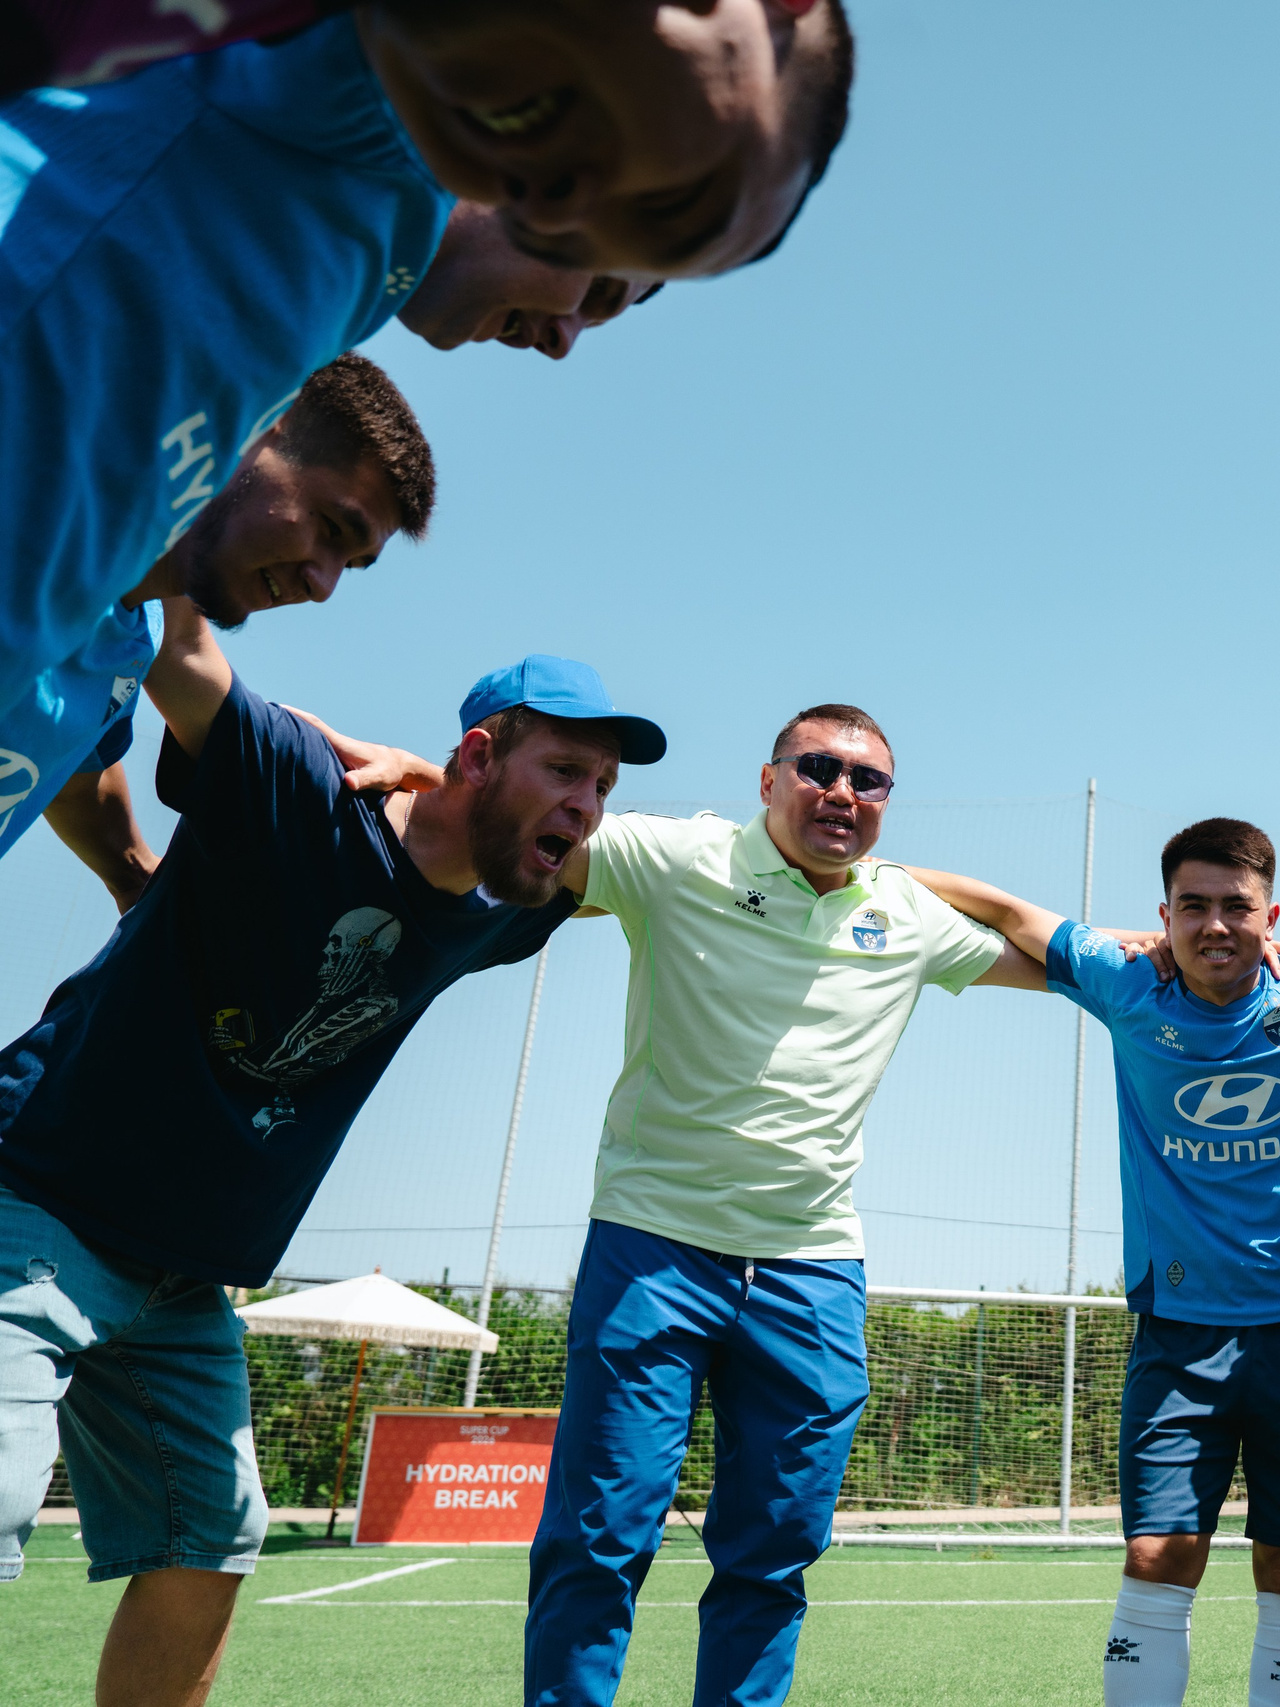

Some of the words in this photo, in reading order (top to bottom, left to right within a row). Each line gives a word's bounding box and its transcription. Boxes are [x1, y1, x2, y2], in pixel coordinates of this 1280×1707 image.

[734, 900, 767, 918] KELME
[1155, 1036, 1185, 1051] KELME
[460, 1425, 489, 1435] SUPER
[490, 1425, 510, 1435] CUP
[405, 1464, 546, 1484] HYDRATION
[434, 1490, 519, 1509] BREAK
